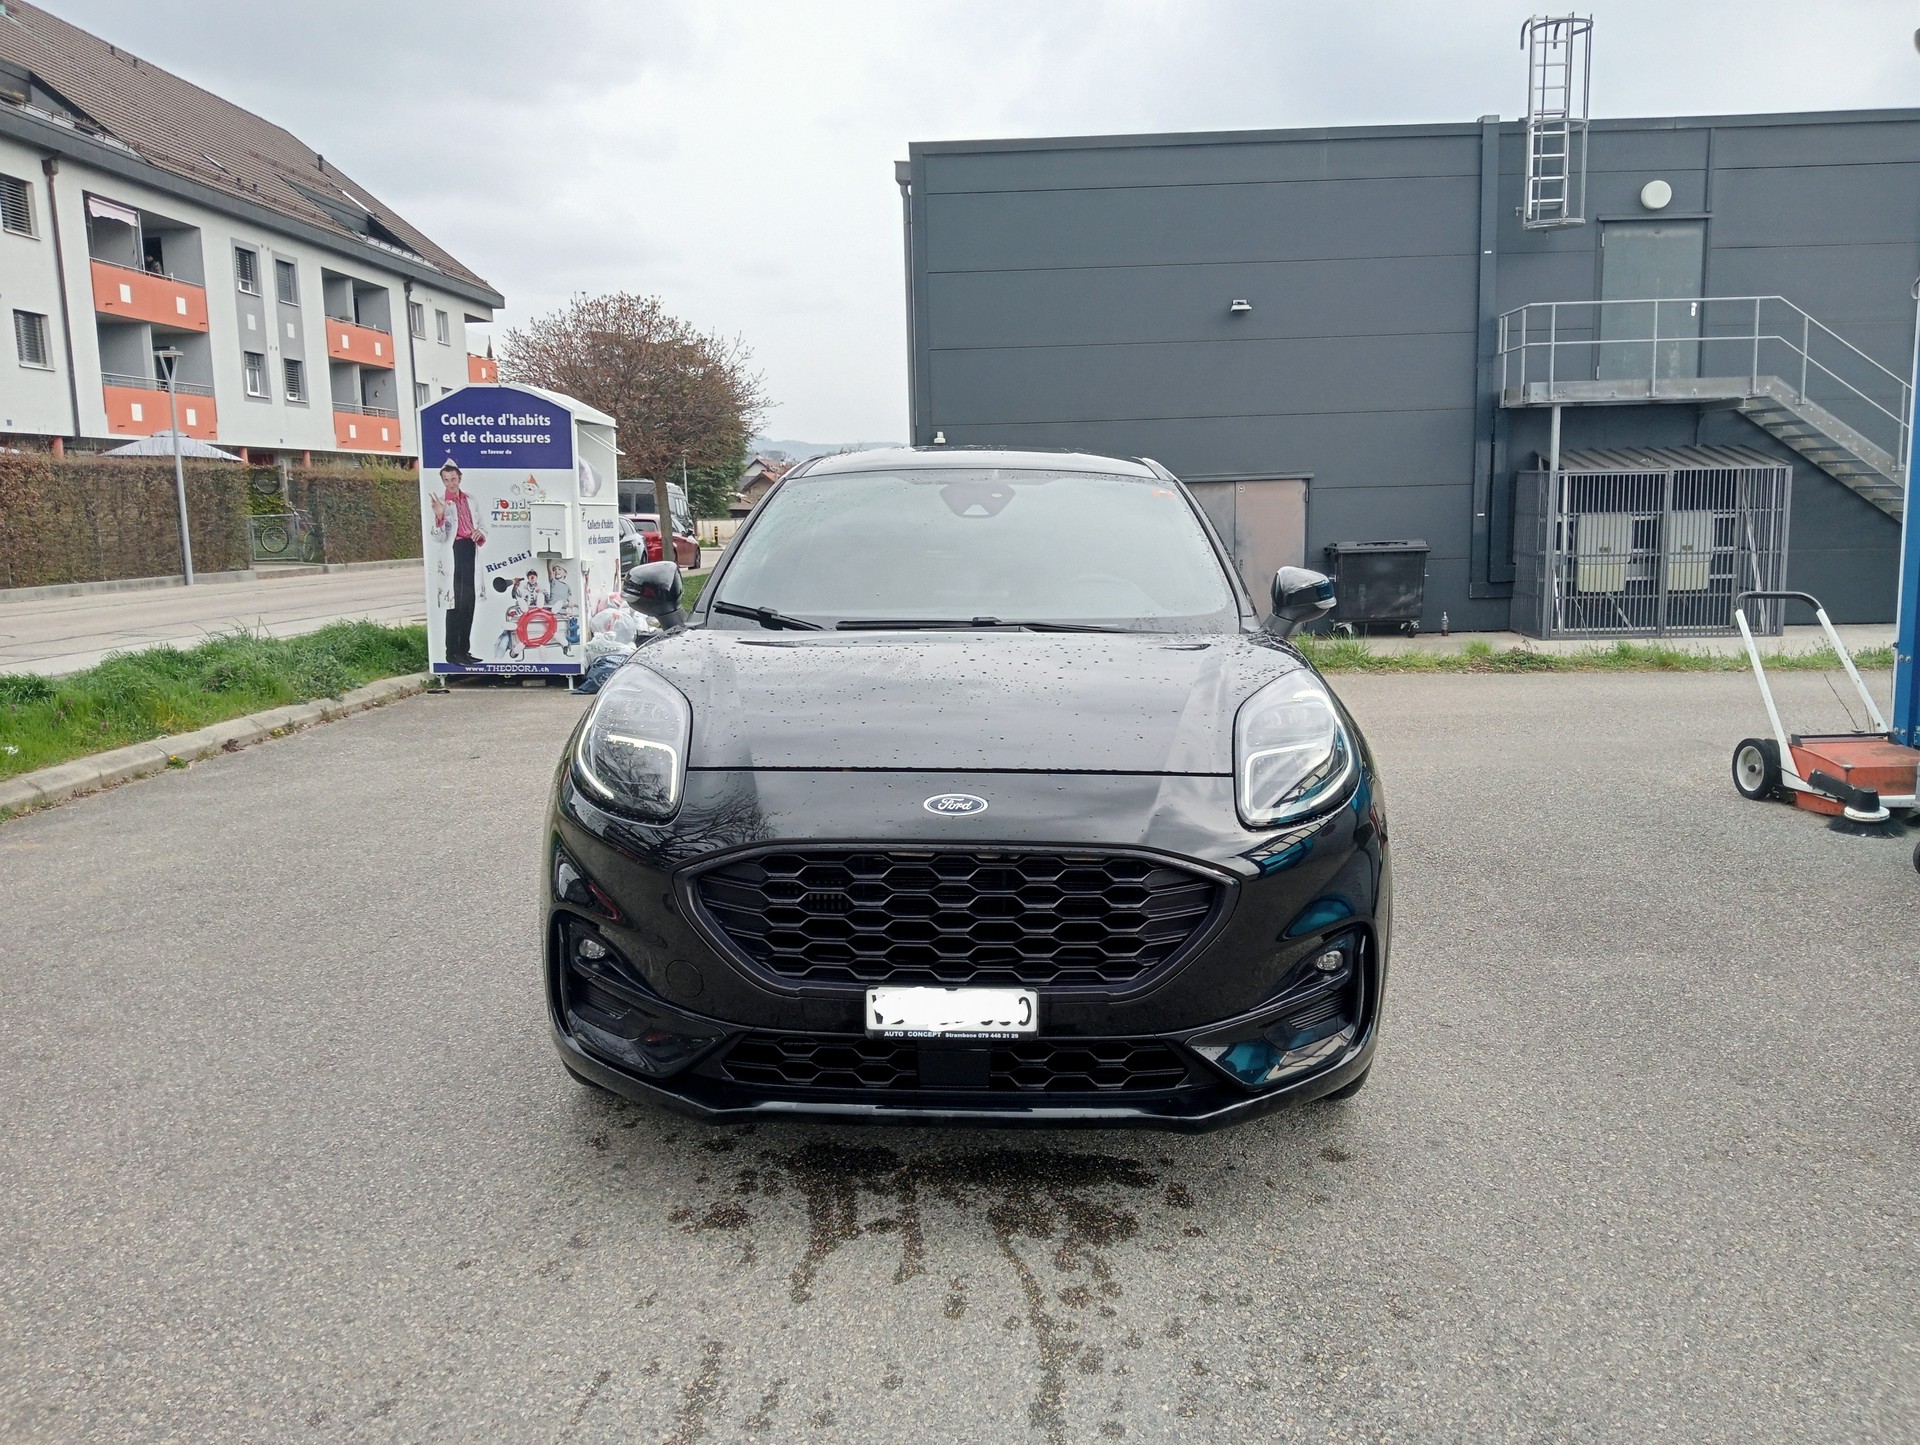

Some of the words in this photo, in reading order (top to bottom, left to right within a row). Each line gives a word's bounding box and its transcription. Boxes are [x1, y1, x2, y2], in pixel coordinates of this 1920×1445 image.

[440, 413, 495, 426] Collecte
[497, 413, 551, 426] d'habits
[442, 432, 456, 443] et
[459, 430, 476, 443] de
[479, 430, 551, 443] chaussures
[486, 560, 508, 573] Rire
[508, 552, 527, 565] fait
[465, 664, 550, 673] www.THEODORA.ch
[937, 797, 973, 811] Ford
[883, 1030, 904, 1038] AUTO
[907, 1030, 942, 1038] CONCEPT
